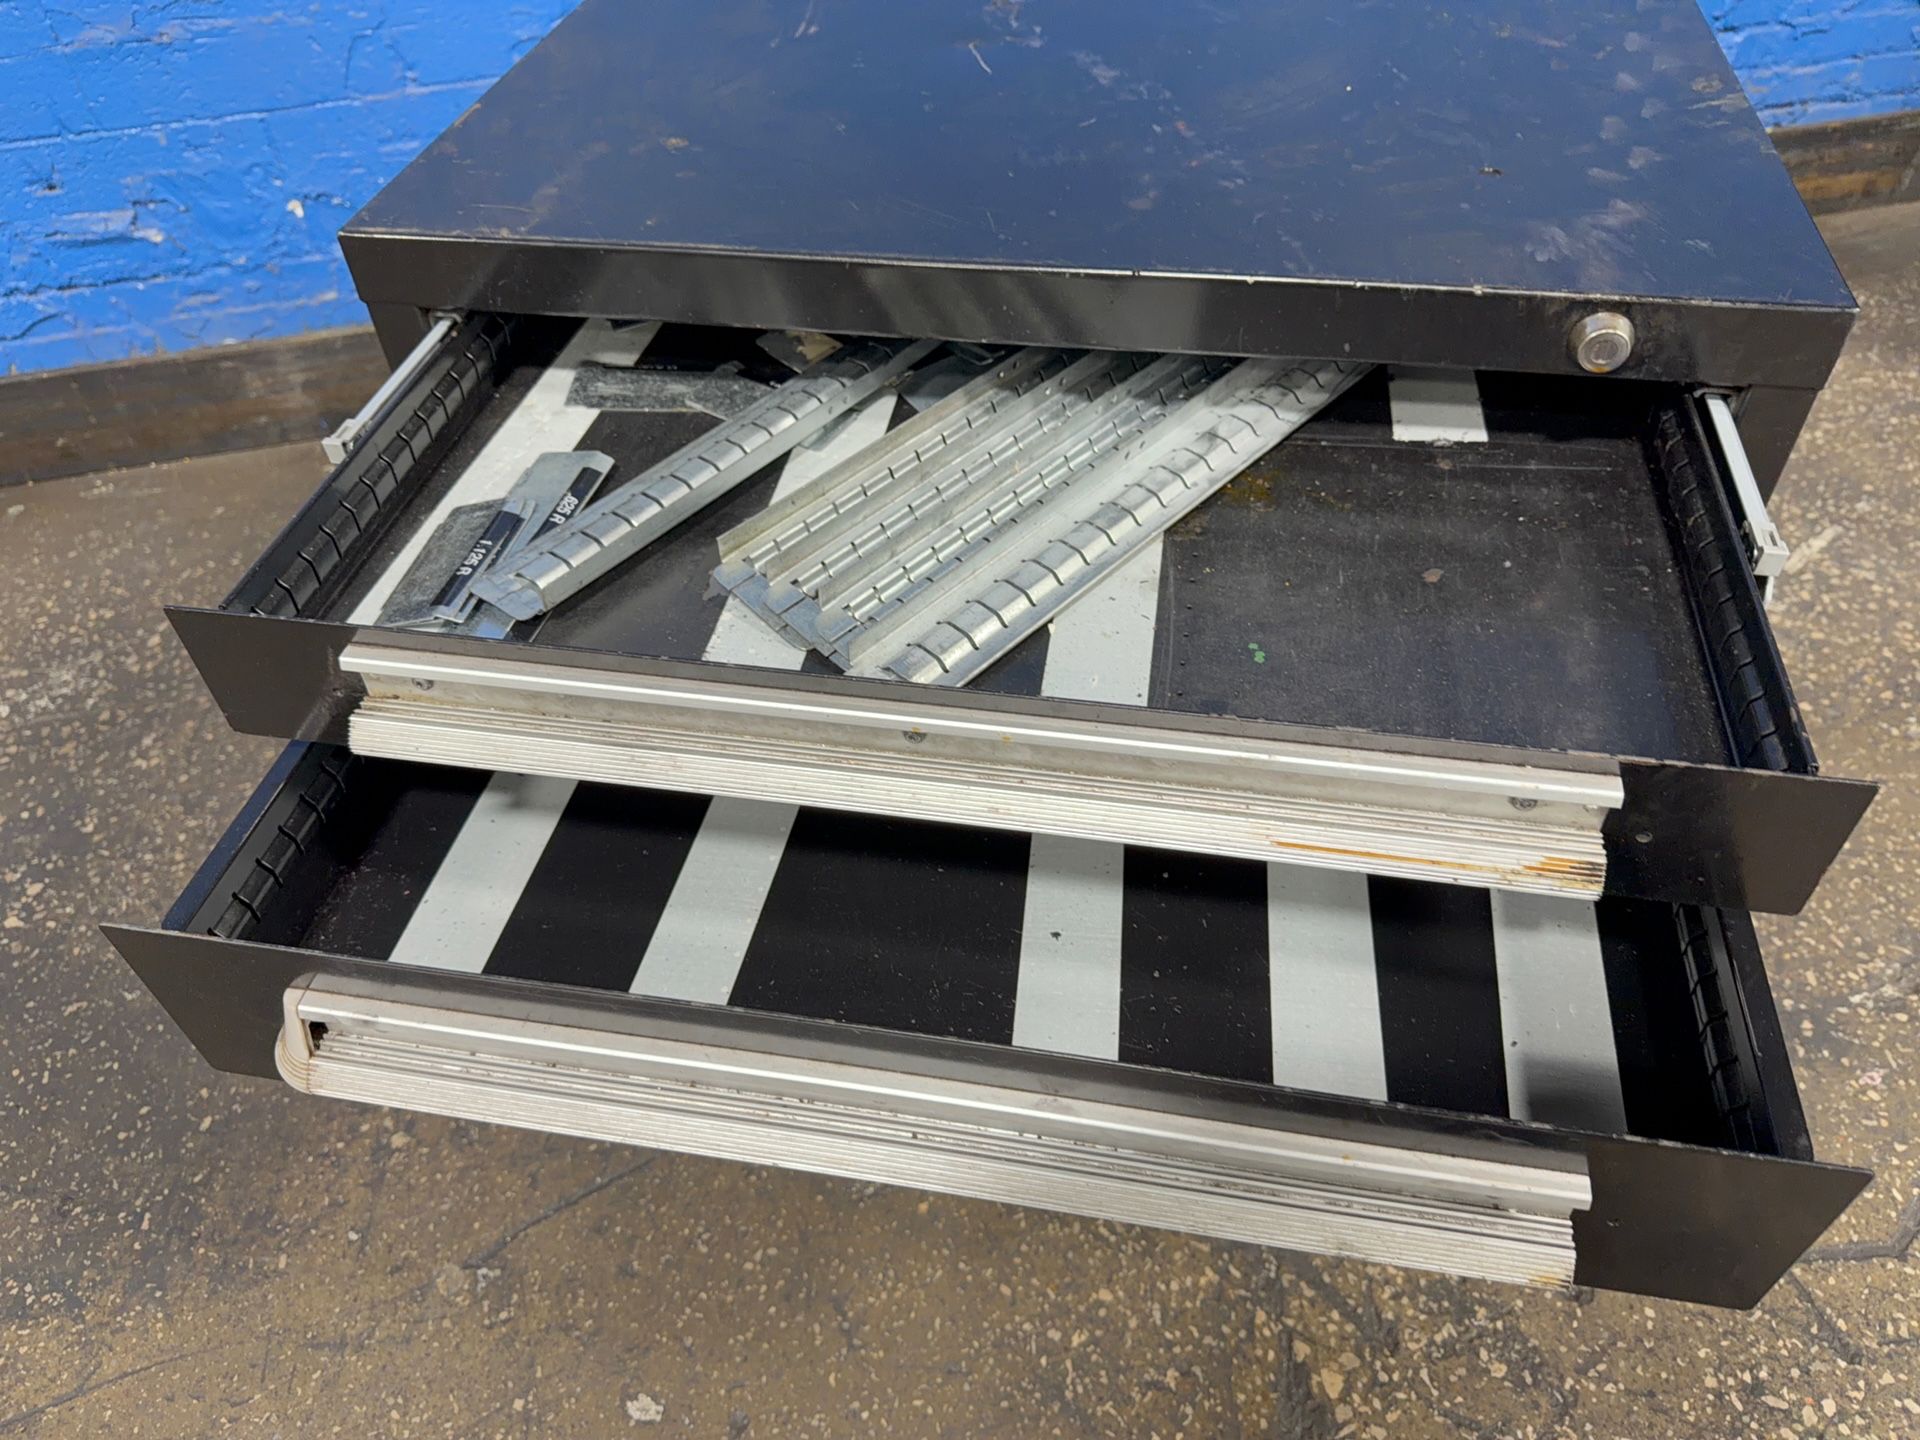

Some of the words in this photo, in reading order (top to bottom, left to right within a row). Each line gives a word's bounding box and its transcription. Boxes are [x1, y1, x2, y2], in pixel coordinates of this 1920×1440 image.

[549, 512, 566, 524] R
[463, 540, 493, 567] 1.125
[456, 566, 472, 577] R
